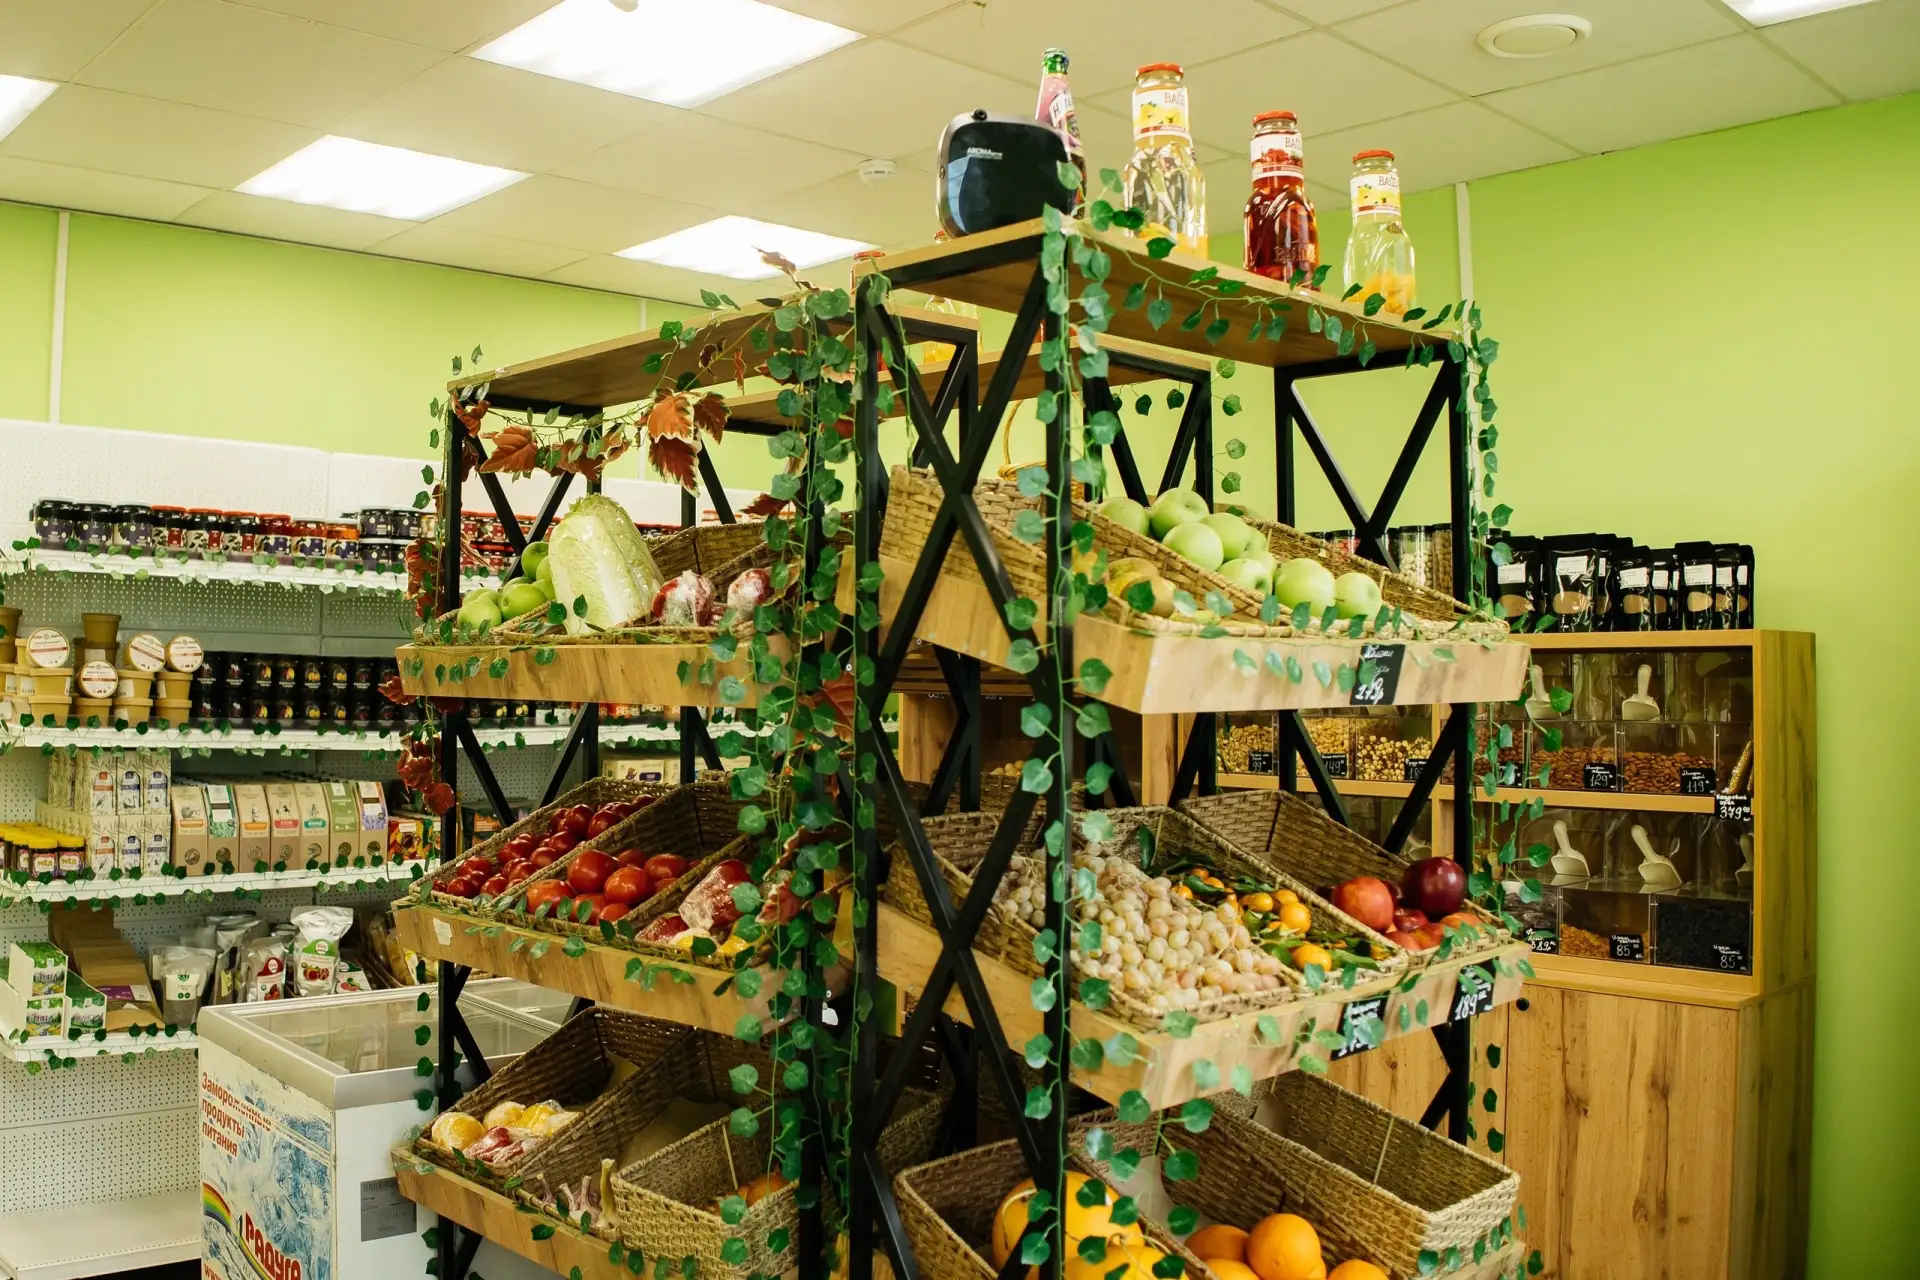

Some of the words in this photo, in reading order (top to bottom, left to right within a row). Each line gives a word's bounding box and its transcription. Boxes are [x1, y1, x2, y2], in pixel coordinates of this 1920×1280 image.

[1589, 774, 1608, 787] 129
[1687, 780, 1705, 793] 119
[1719, 806, 1742, 820] 379
[1616, 944, 1631, 957] 85
[1720, 954, 1736, 969] 85
[1454, 994, 1477, 1020] 189
[202, 1099, 245, 1139] продукты
[202, 1121, 238, 1157] питания
